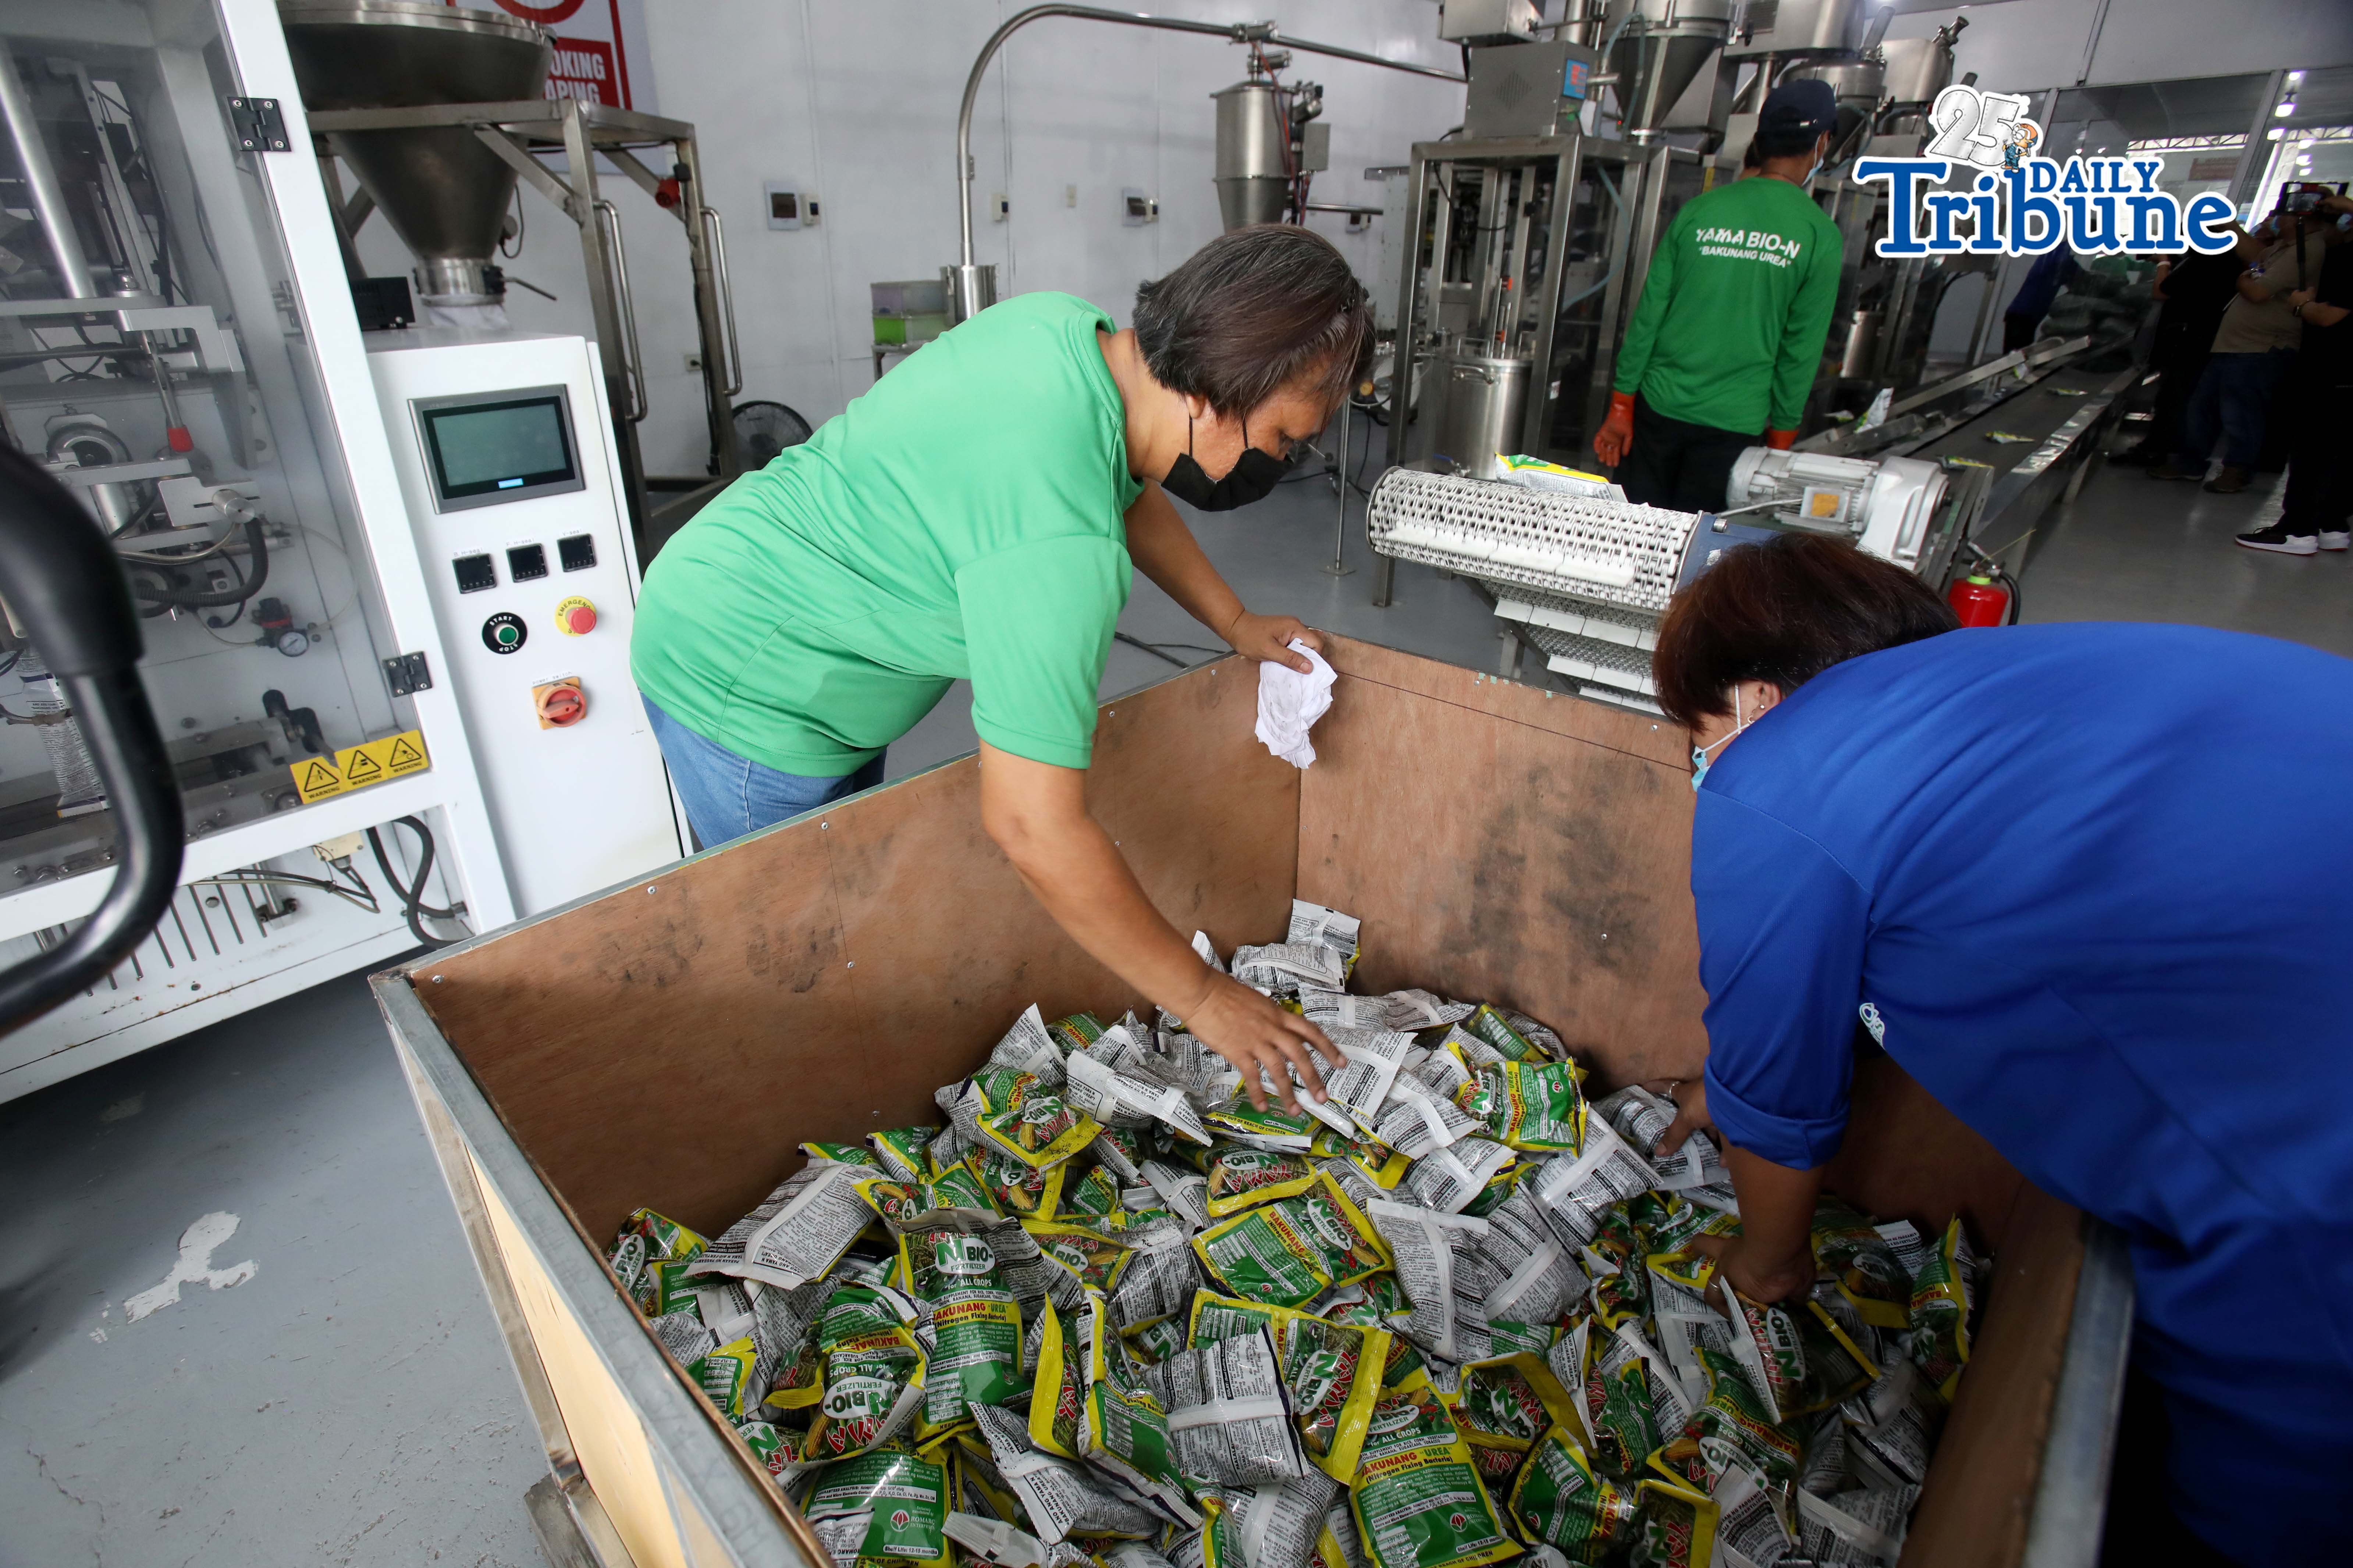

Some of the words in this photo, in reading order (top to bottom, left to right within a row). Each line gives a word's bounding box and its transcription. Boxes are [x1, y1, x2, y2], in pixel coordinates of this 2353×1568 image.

[550, 50, 606, 81] OKING
[545, 78, 601, 105] APING
[1696, 228, 1744, 246] YAMA
[1746, 231, 1801, 259] BIO-N
[1759, 252, 1791, 268] UREA"
[490, 616, 512, 626] START
[499, 644, 518, 652] STOP
[553, 671, 572, 680] switch
[393, 761, 423, 773] WARNING
[352, 773, 382, 785] WARNING
[308, 787, 340, 798] WARNING
[1025, 1107, 1048, 1121] BIO-
[1244, 1120, 1258, 1128] REACH
[1224, 1155, 1256, 1166] BIO-
[1290, 1217, 1304, 1233] SUPPLEMENT
[1311, 1212, 1337, 1241] FERTILIZER
[1267, 1220, 1287, 1243] (Nitrogen
[1269, 1211, 1305, 1252] BAKUNANG
[1304, 1223, 1315, 1234] ALL
[1313, 1232, 1329, 1250] CROPS
[1326, 1219, 1349, 1248] BIO-
[935, 1238, 965, 1267] N
[966, 1246, 993, 1262] BIO-
[950, 1263, 986, 1271] FERTILIZER
[960, 1278, 971, 1286] ALL
[943, 1291, 969, 1300] SUPPLEMENT
[938, 1299, 951, 1307] ONION,
[988, 1303, 1009, 1314] "UREA"
[935, 1314, 969, 1329] (Nitrogen
[971, 1312, 987, 1321] Fixing
[988, 1313, 1006, 1322] Bacteria)
[836, 1337, 860, 1348] Fixing
[947, 1336, 967, 1345] nananatili
[859, 1364, 873, 1373] ALL
[930, 1359, 953, 1368] GUARANTEED
[830, 1366, 857, 1377] CROPS
[836, 1382, 882, 1393] FERTILIZER
[825, 1390, 866, 1413] BIO-
[1299, 1379, 1323, 1413] BIO-
[1369, 1417, 1409, 1433] FERTILIZER
[1382, 1435, 1396, 1444] ALL
[1396, 1427, 1421, 1439] CROPS
[1369, 1446, 1393, 1457] SUPPLEMENT
[1362, 1452, 1418, 1477] AKUNANG
[1420, 1447, 1453, 1457] "UREA"
[1366, 1467, 1400, 1485] (Nitrogen
[1401, 1460, 1423, 1470] Fixing
[1424, 1456, 1453, 1465] Bacteria)
[1399, 1472, 1419, 1481] organismo
[817, 1487, 840, 1496] GUARANTEED
[1034, 1482, 1046, 1498] YAMA
[1044, 1498, 1054, 1511] ANG
[1052, 1512, 1063, 1525] ANO
[1373, 1512, 1395, 1524] GUARANTEED
[1466, 1550, 1493, 1561] CHILDREN
